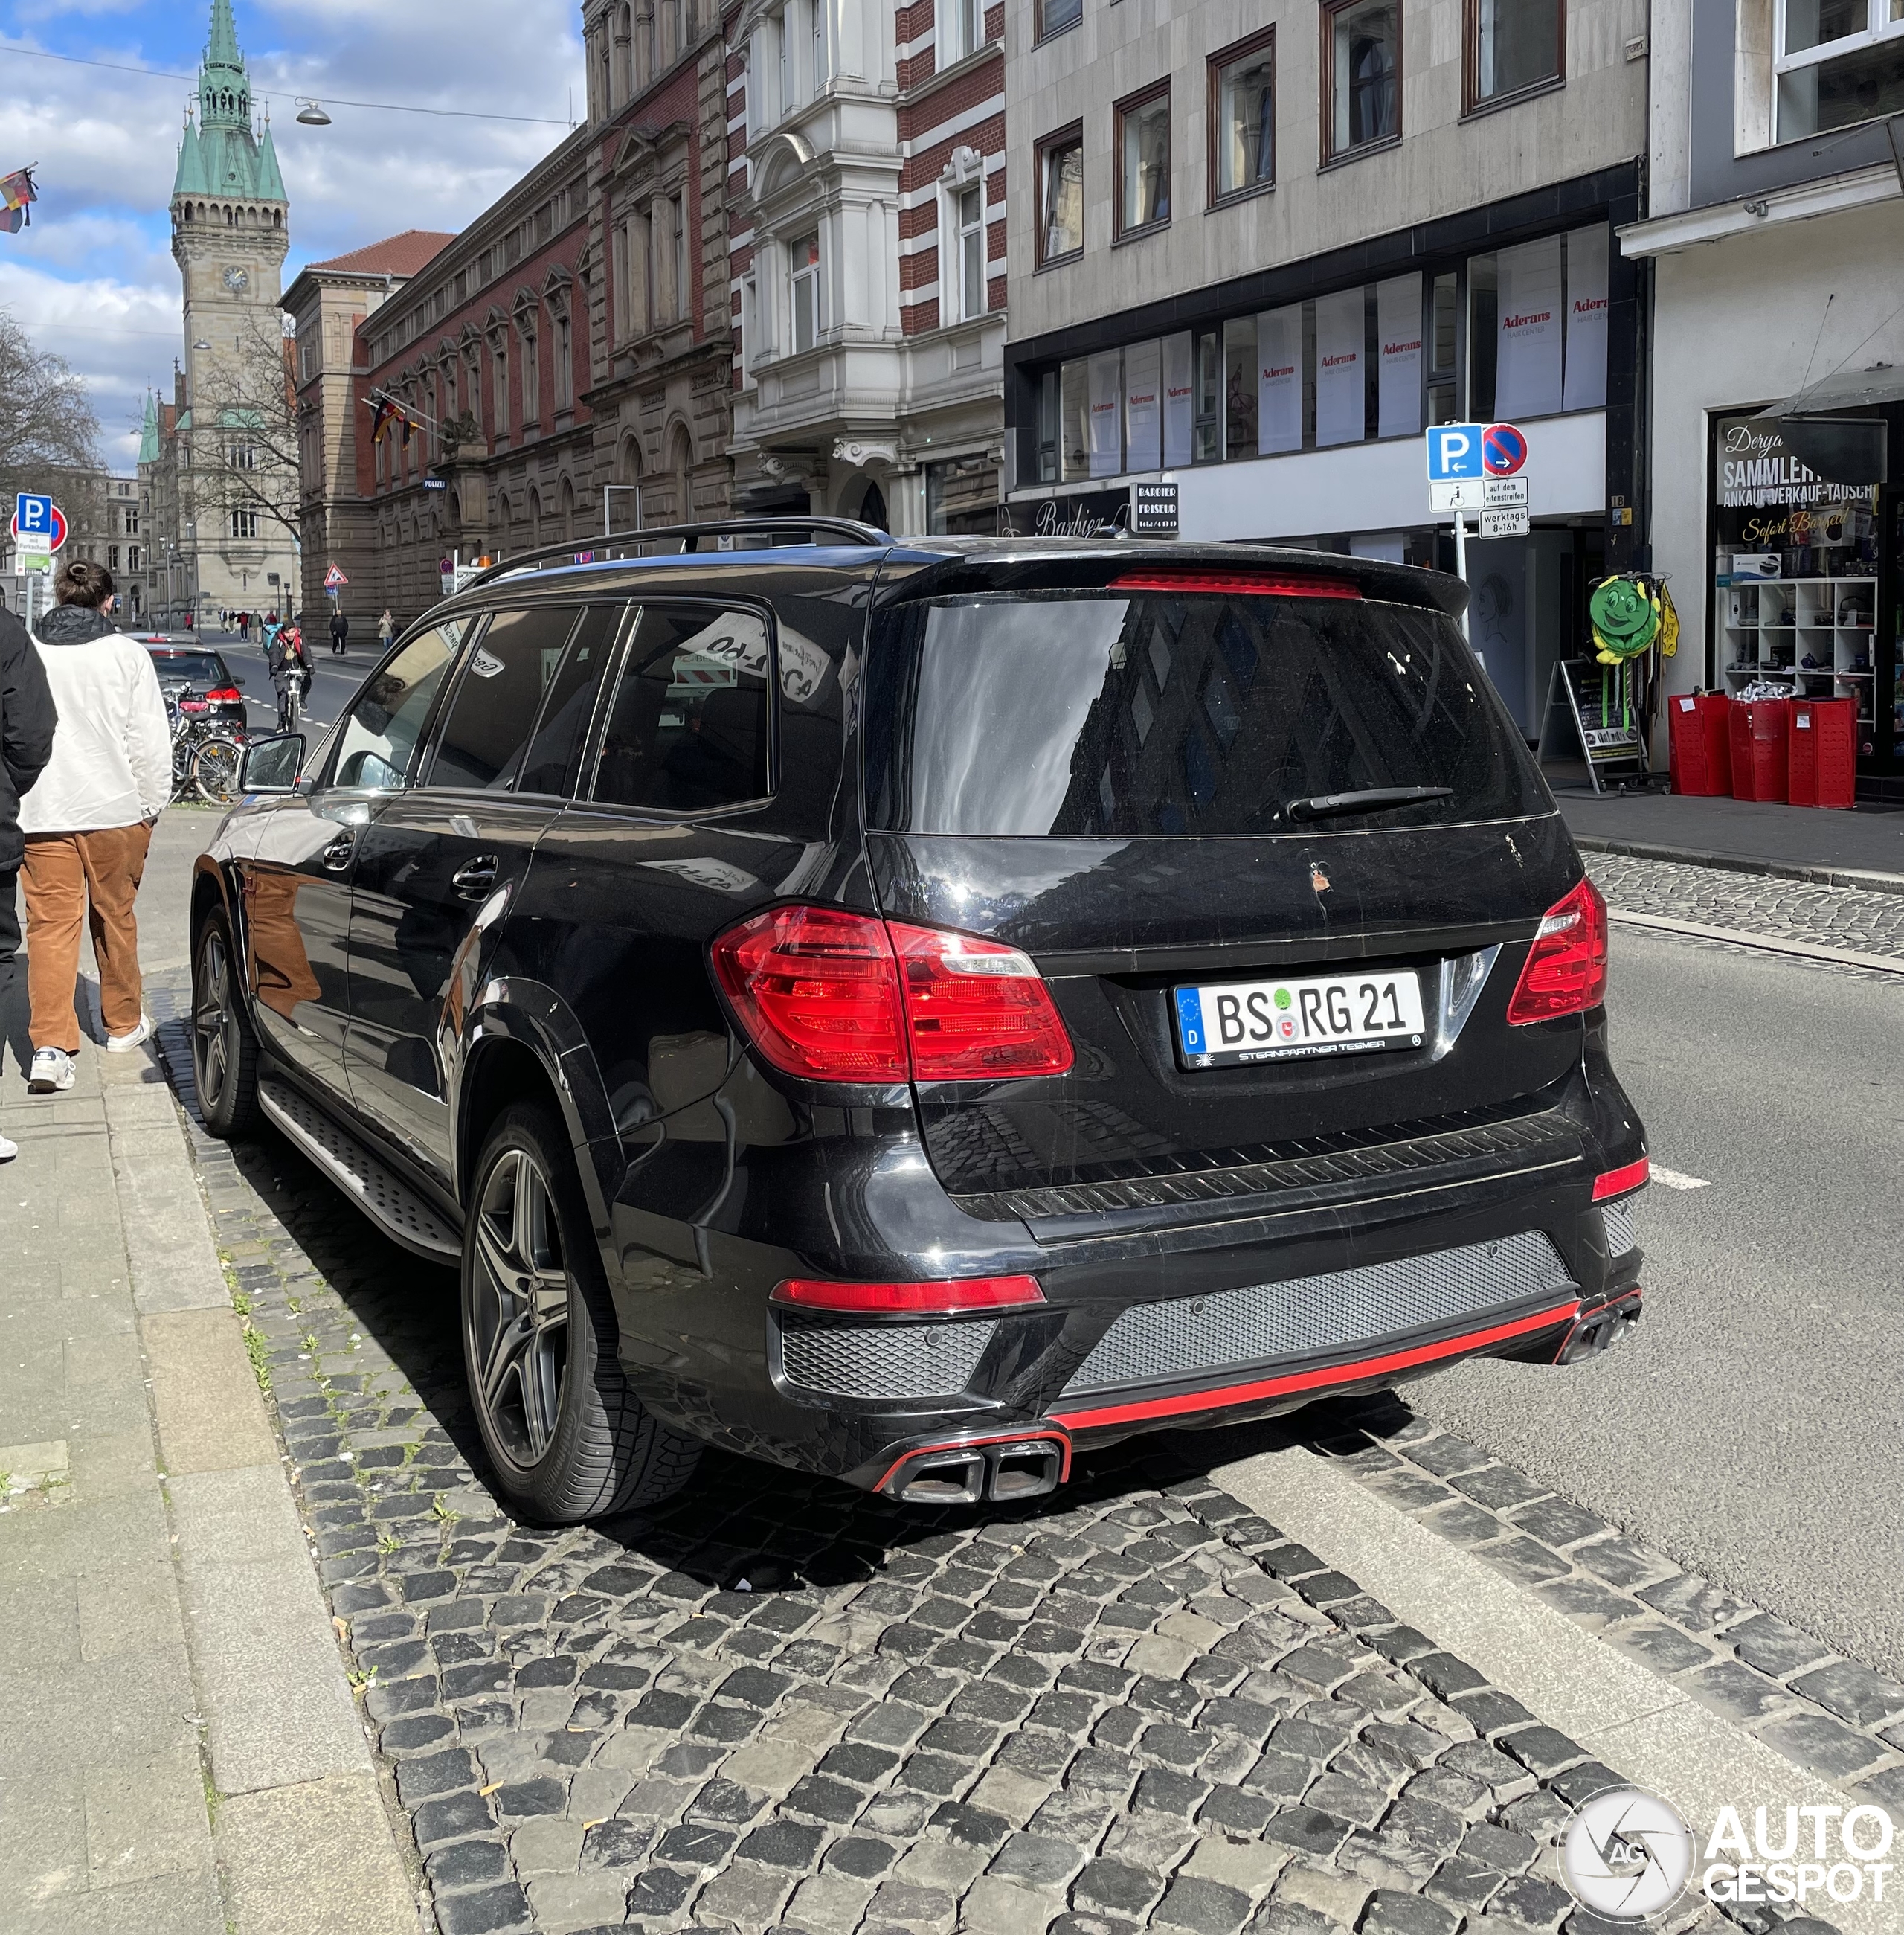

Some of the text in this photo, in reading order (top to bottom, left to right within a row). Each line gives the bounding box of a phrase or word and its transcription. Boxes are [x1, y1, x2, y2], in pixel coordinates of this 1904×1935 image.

[1502, 311, 1551, 330] Aderans
[1577, 314, 1592, 324] HAIR
[1522, 326, 1545, 336] CENTER
[1383, 340, 1421, 356] Aderans
[1321, 353, 1357, 368] Aderans
[1386, 354, 1416, 365] HAIR CENTER
[1262, 365, 1294, 379] Aderans
[1091, 402, 1115, 414] Aderans
[1725, 425, 1784, 458] Derya
[1440, 432, 1470, 473] P
[425, 480, 446, 488] POLIZEI
[1490, 483, 1516, 492] auf dem
[1139, 487, 1176, 497] BARBIER
[1486, 492, 1525, 503] eitenstreifen
[25, 499, 44, 528] P
[1139, 504, 1177, 513] FRISEUR
[1485, 512, 1525, 522] werktags
[1742, 518, 1786, 545] Sofort
[1217, 982, 1406, 1044] BS RG 21
[1188, 1030, 1198, 1045] D
[1238, 1040, 1386, 1061] STERNPARTNER TESMER
